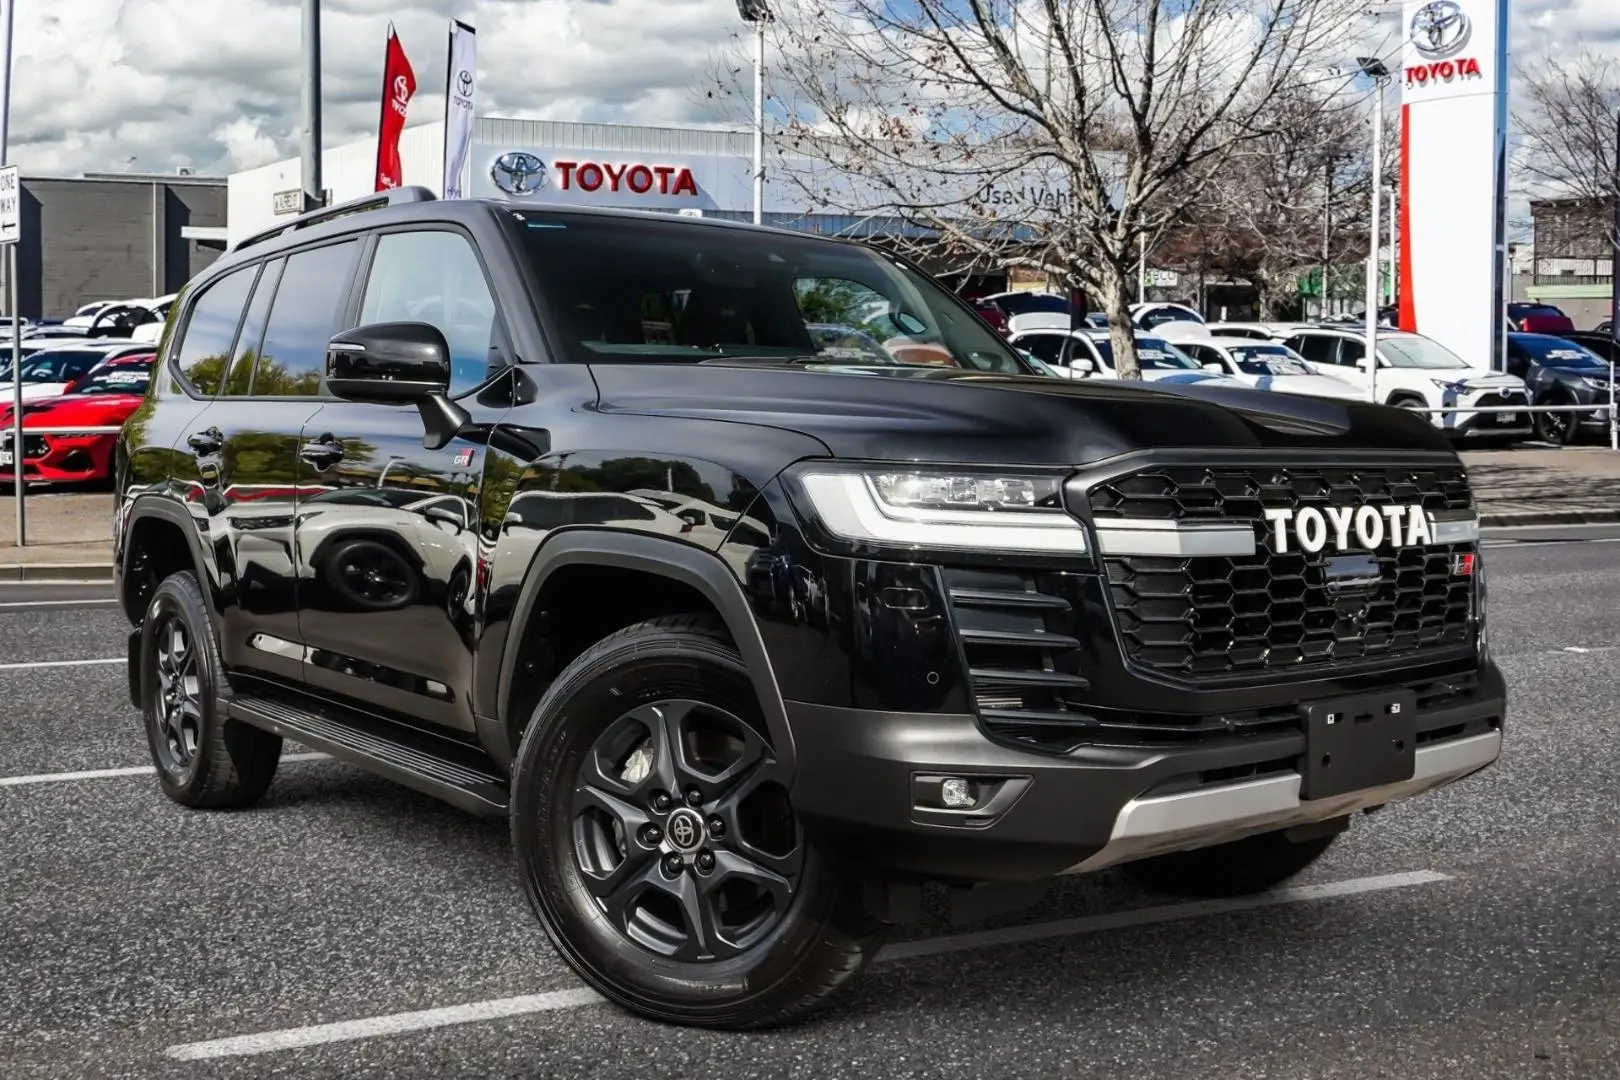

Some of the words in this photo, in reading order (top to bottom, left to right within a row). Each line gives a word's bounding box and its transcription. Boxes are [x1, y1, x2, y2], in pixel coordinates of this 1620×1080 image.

[1404, 58, 1480, 83] TOYOTA
[453, 96, 473, 110] TOYOTA
[1, 173, 15, 191] ONE
[555, 161, 698, 196] TOYOTA
[1, 196, 16, 213] WAY
[1264, 504, 1435, 553] TOYOTA
